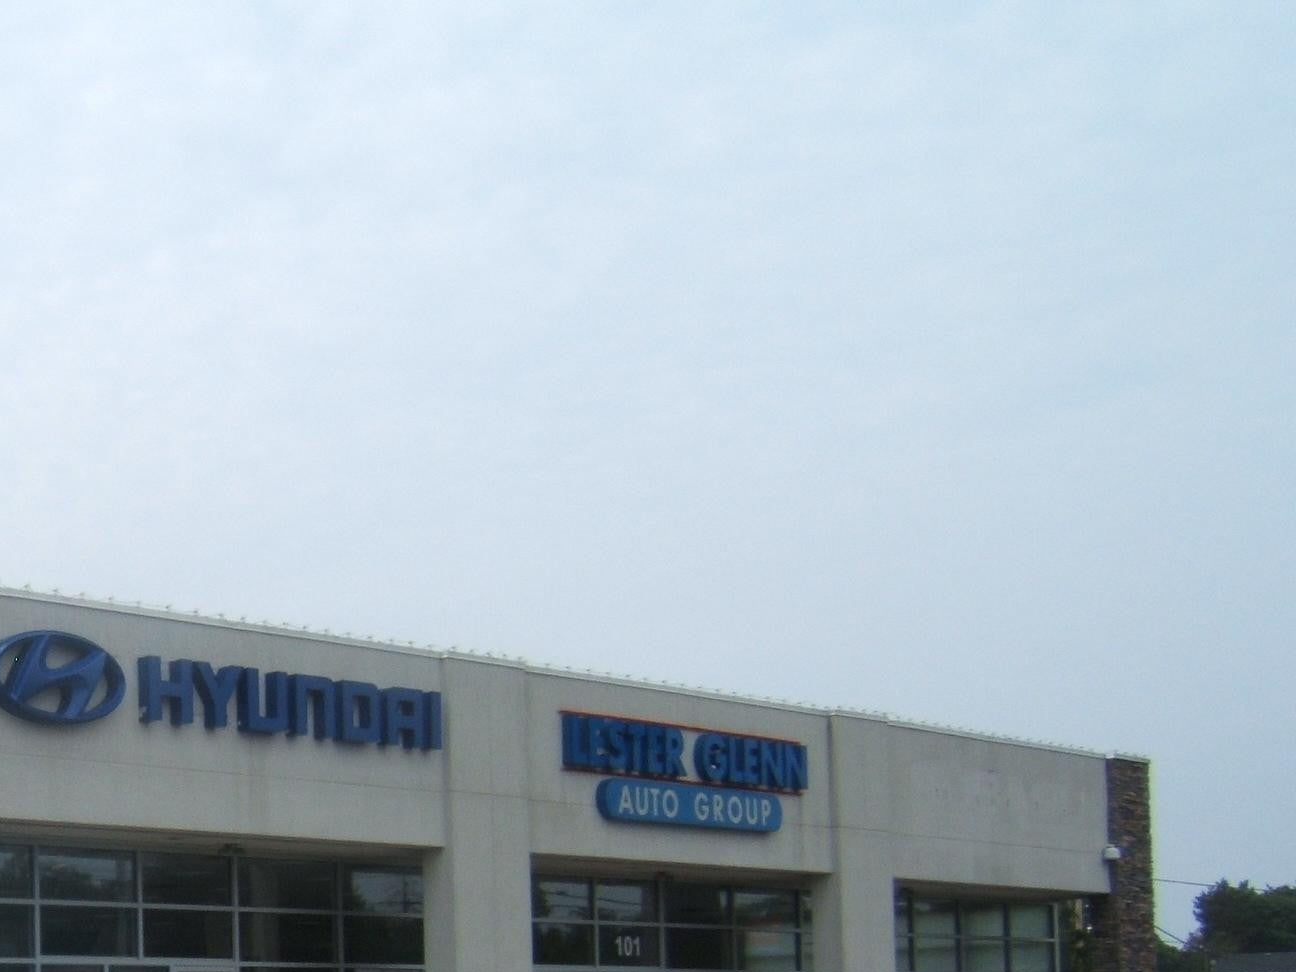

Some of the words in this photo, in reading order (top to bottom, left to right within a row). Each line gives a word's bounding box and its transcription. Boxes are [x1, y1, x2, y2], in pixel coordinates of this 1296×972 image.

[137, 655, 442, 750] HYUNDAI
[562, 714, 687, 776] LESTER
[693, 732, 808, 790] GLENN
[618, 785, 679, 818] AUTO
[694, 792, 772, 825] GROUP
[615, 936, 640, 956] 101
